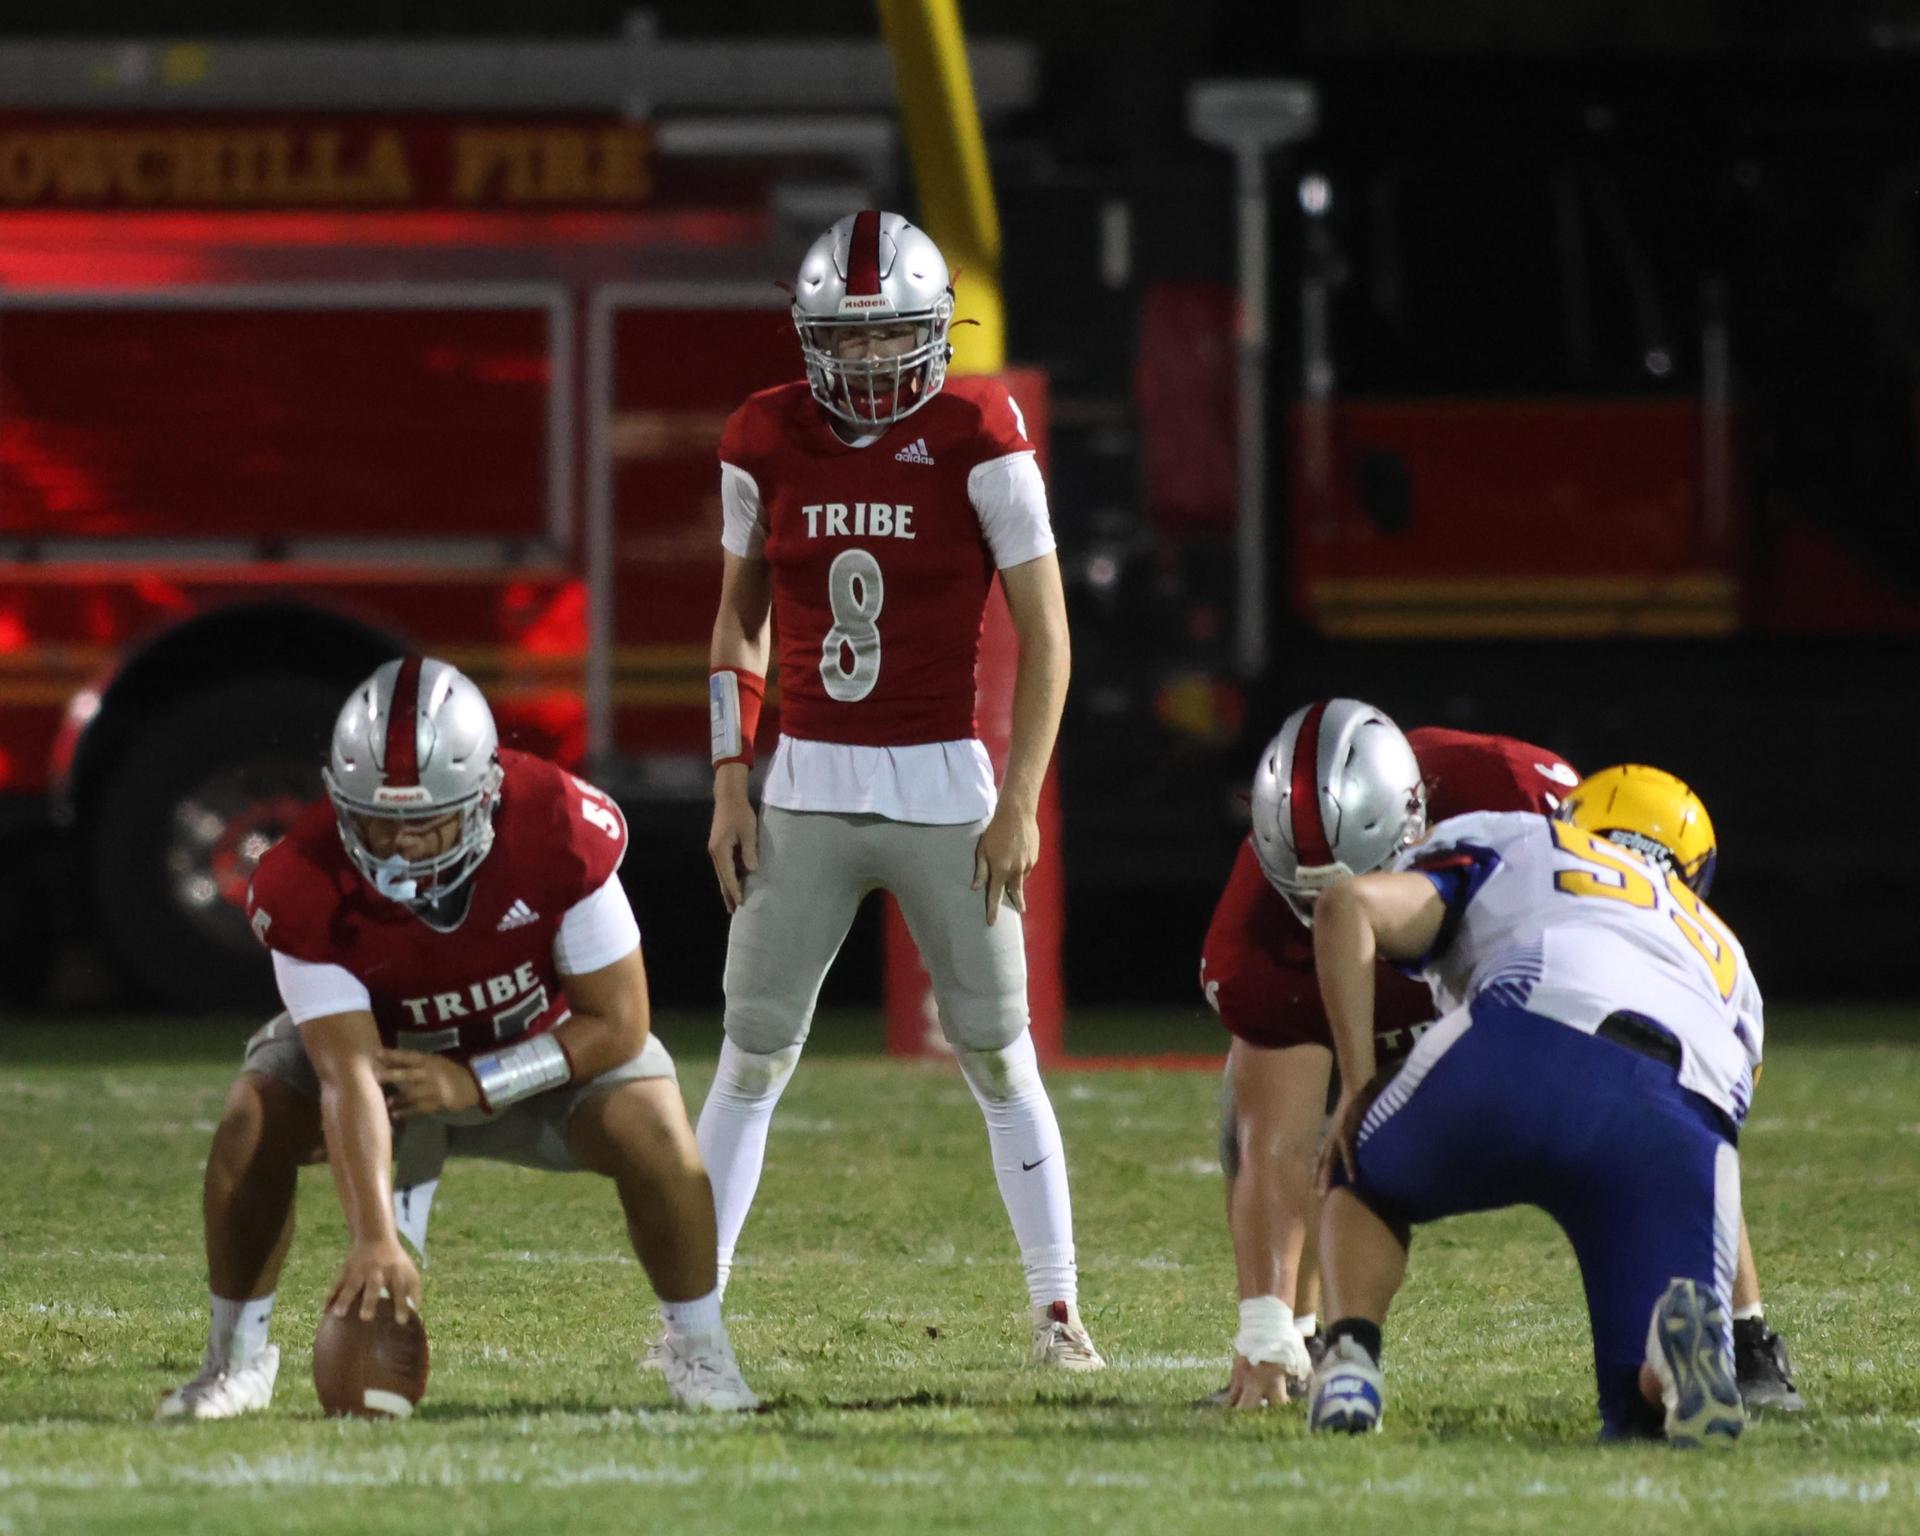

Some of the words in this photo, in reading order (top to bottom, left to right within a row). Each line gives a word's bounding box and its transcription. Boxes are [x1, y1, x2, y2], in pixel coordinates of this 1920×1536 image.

[453, 126, 652, 200] FIRE
[895, 452, 935, 465] adidas
[802, 502, 916, 540] TRIBE
[819, 548, 884, 702] 8
[402, 961, 539, 1026] TRIBE
